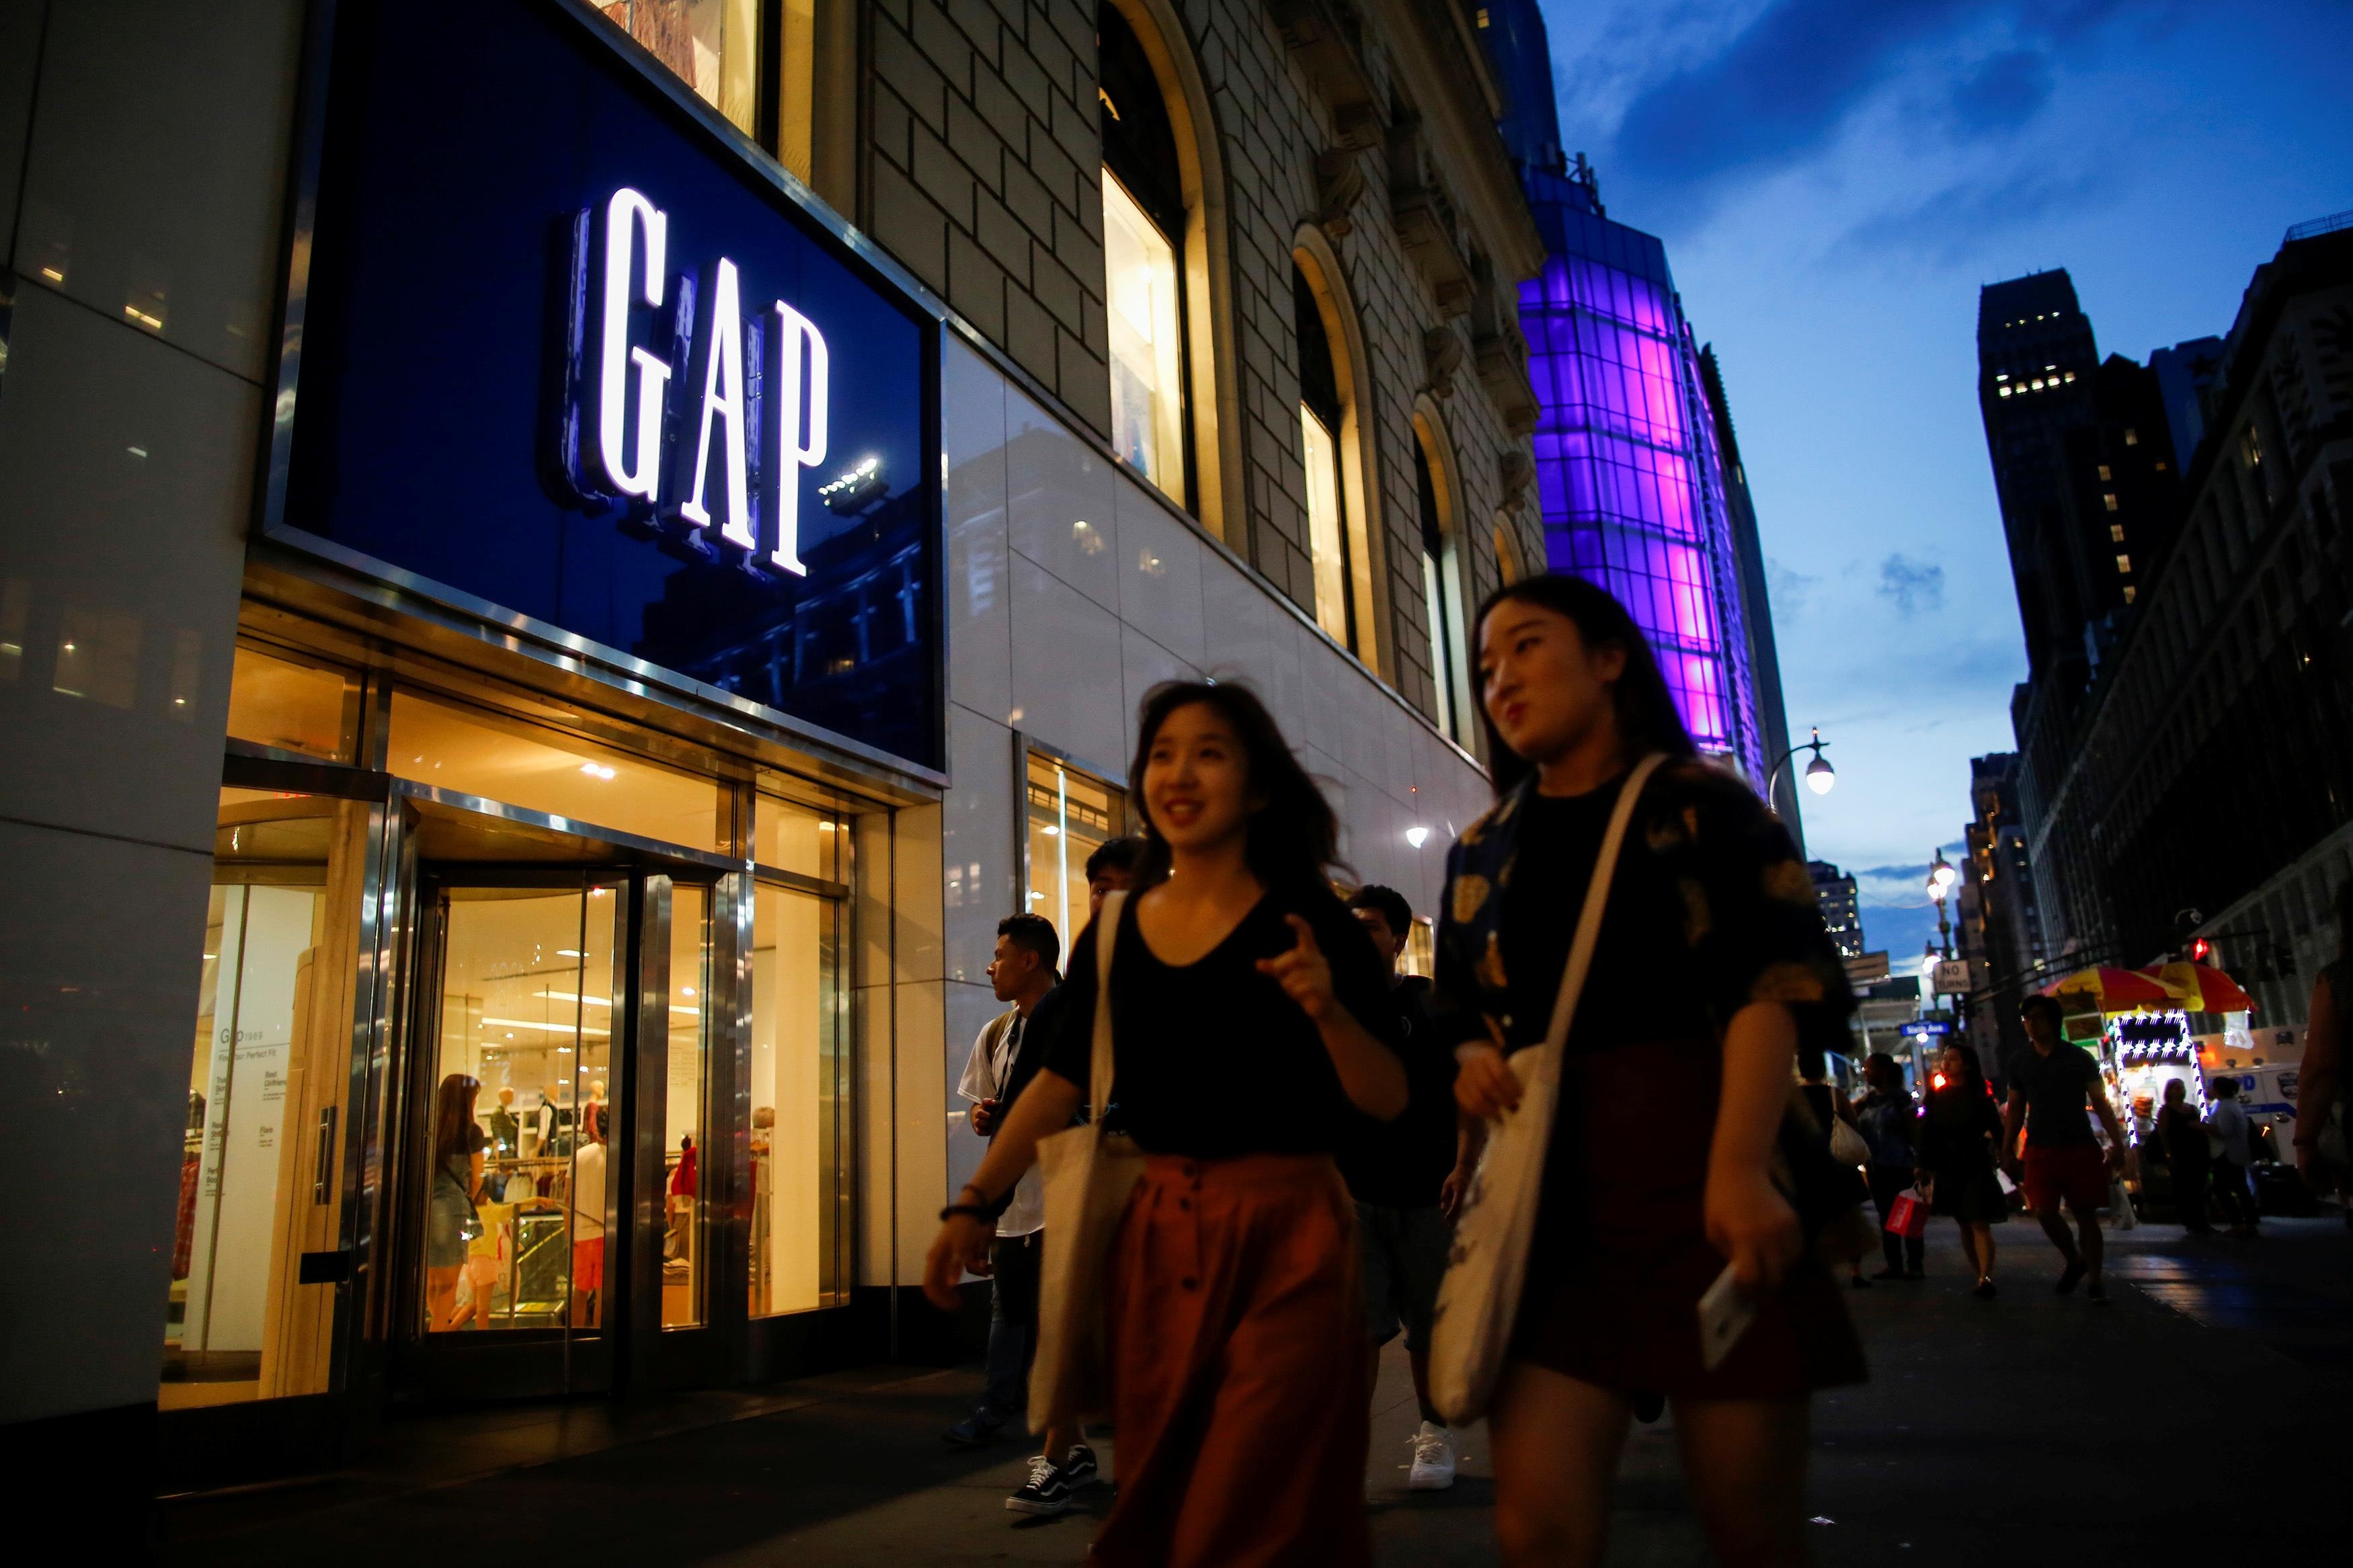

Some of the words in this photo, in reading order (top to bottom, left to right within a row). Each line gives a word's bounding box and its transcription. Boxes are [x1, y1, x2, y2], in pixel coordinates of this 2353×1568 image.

[600, 188, 828, 577] GAP
[1942, 965, 1959, 976] NO
[221, 1028, 243, 1045] Gp
